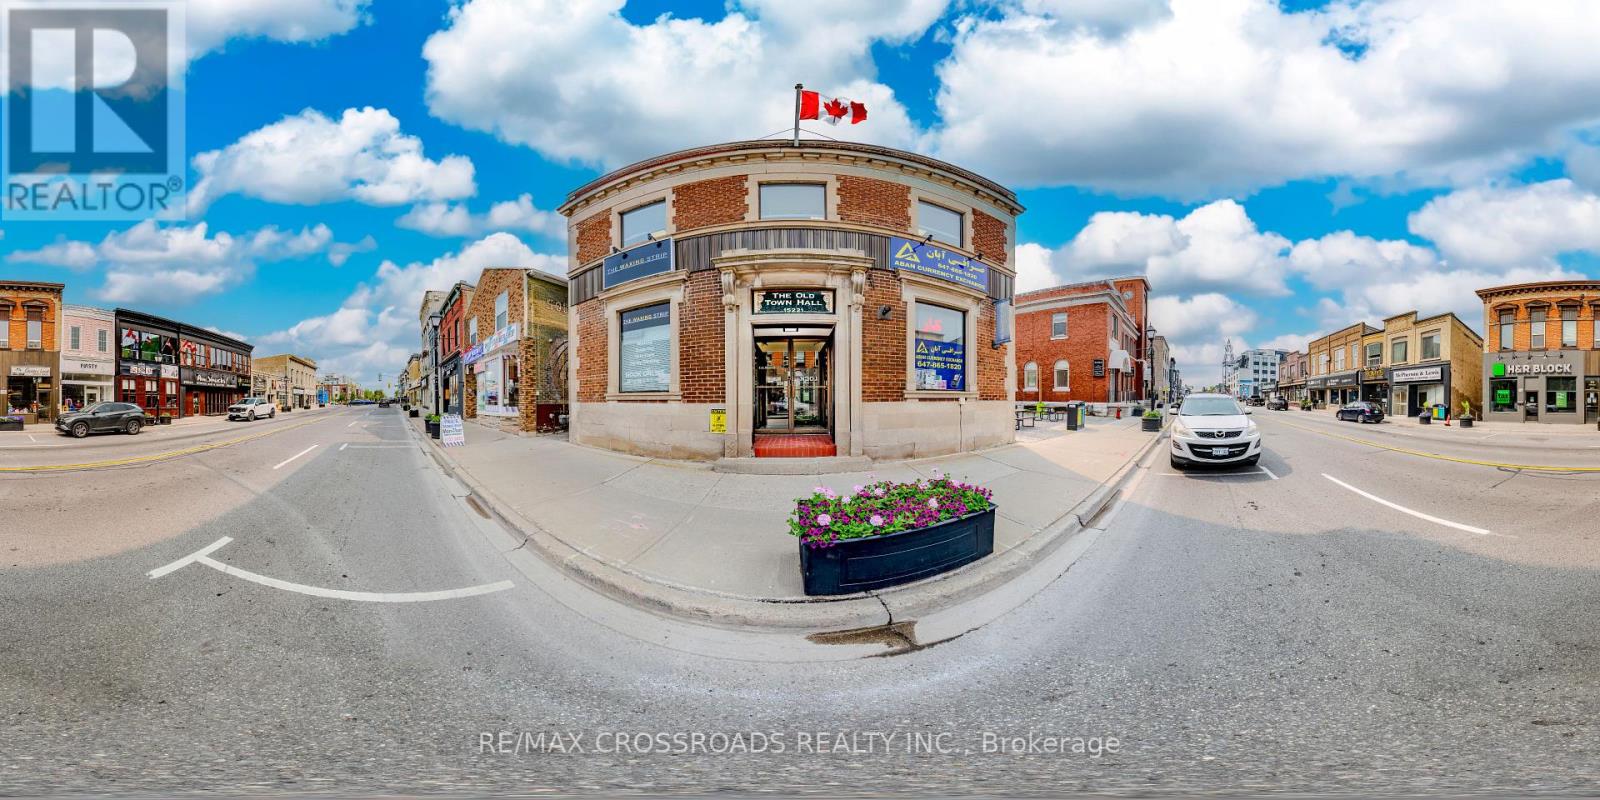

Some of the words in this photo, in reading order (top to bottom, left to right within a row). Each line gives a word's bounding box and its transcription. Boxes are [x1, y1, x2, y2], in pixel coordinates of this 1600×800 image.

[645, 252, 668, 263] STRIP
[895, 260, 916, 269] ABAN
[917, 265, 954, 279] CURRENCY
[955, 276, 986, 290] EXCHANGE
[917, 361, 962, 370] 647-865-1820
[1508, 364, 1530, 374] H&R
[1533, 363, 1572, 374] BLOCK
